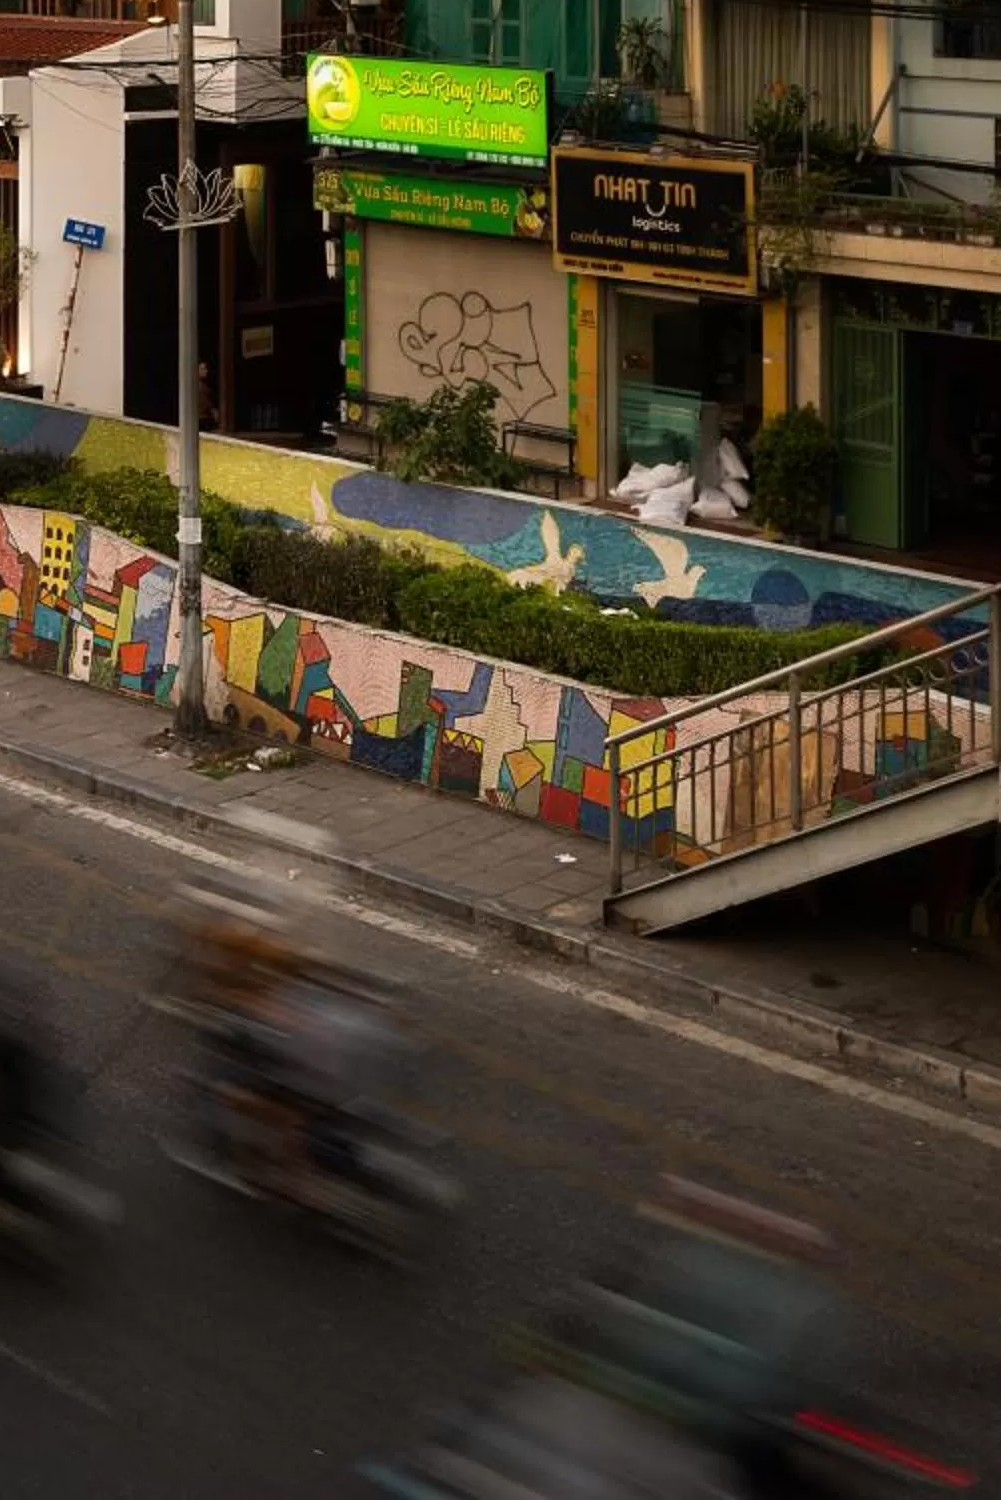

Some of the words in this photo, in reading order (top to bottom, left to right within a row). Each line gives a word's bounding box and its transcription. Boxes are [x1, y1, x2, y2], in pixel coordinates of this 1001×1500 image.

[411, 188, 450, 212] Riêng
[453, 195, 488, 214] Nam
[660, 181, 697, 209] TIN
